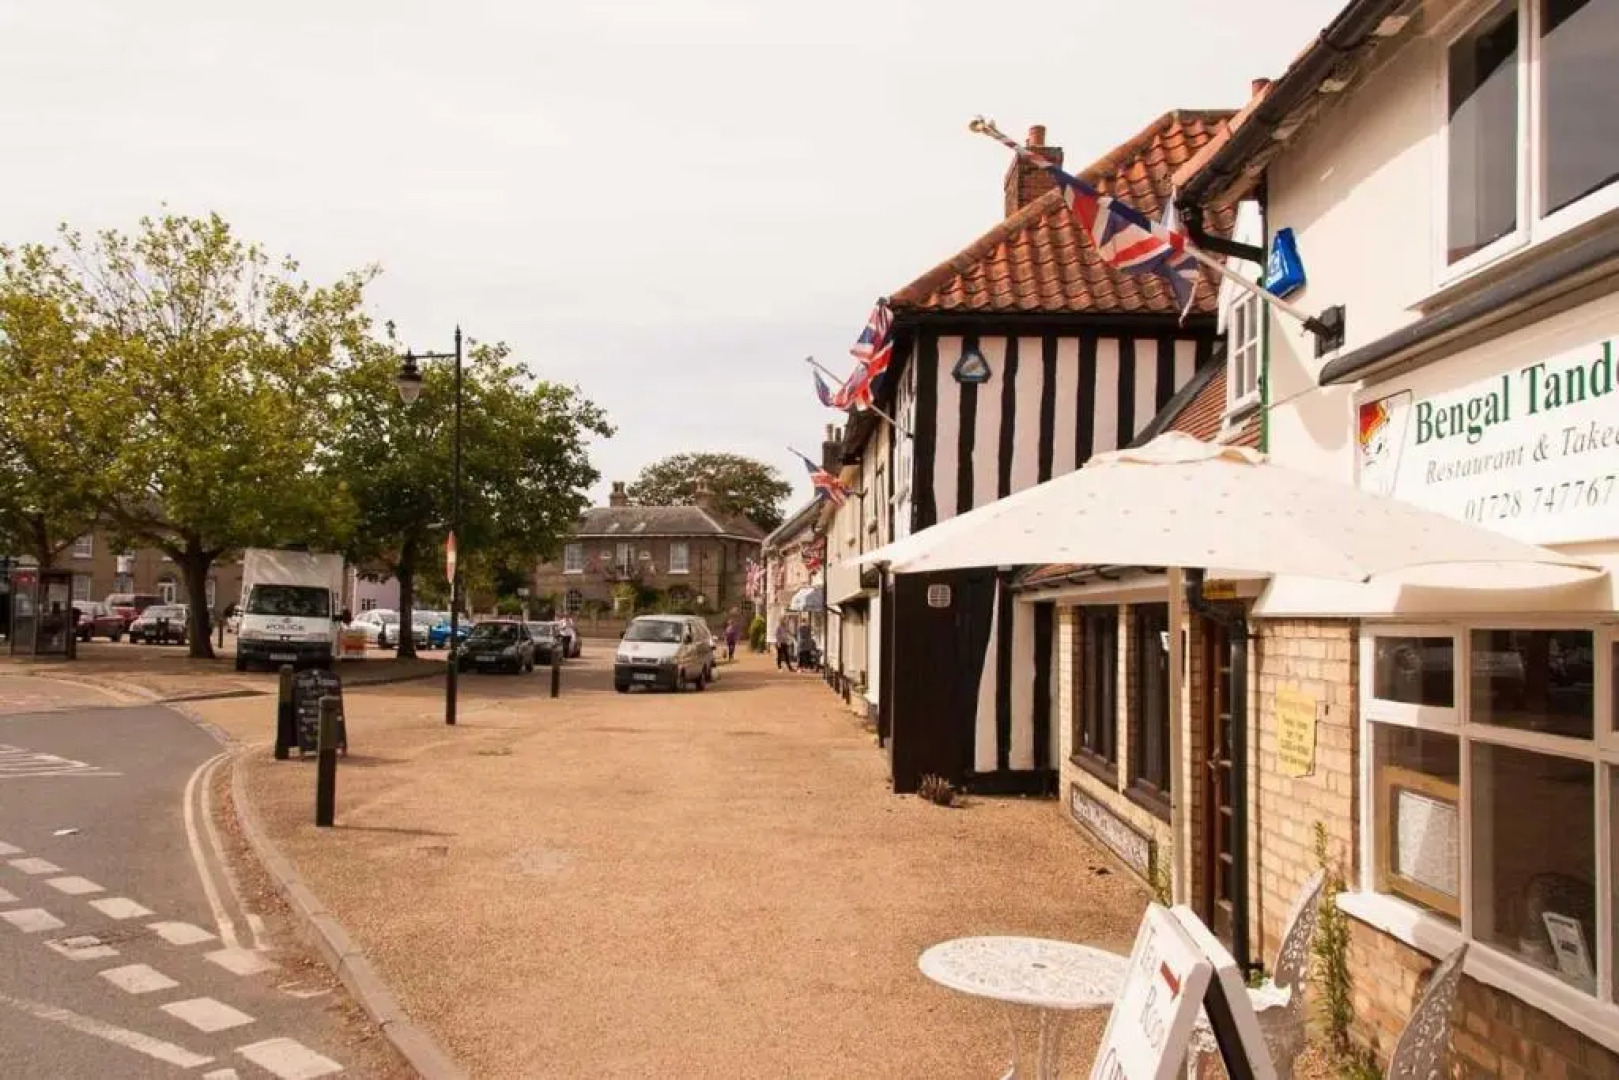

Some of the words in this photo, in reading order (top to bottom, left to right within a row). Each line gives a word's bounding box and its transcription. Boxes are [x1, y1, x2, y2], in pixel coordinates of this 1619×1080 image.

[1414, 374, 1510, 446] Bengal
[1521, 340, 1619, 415] Tand
[1427, 446, 1524, 484] Restaurant
[1533, 433, 1549, 461] &
[1465, 491, 1521, 522] 01728
[1532, 475, 1616, 512] 747767
